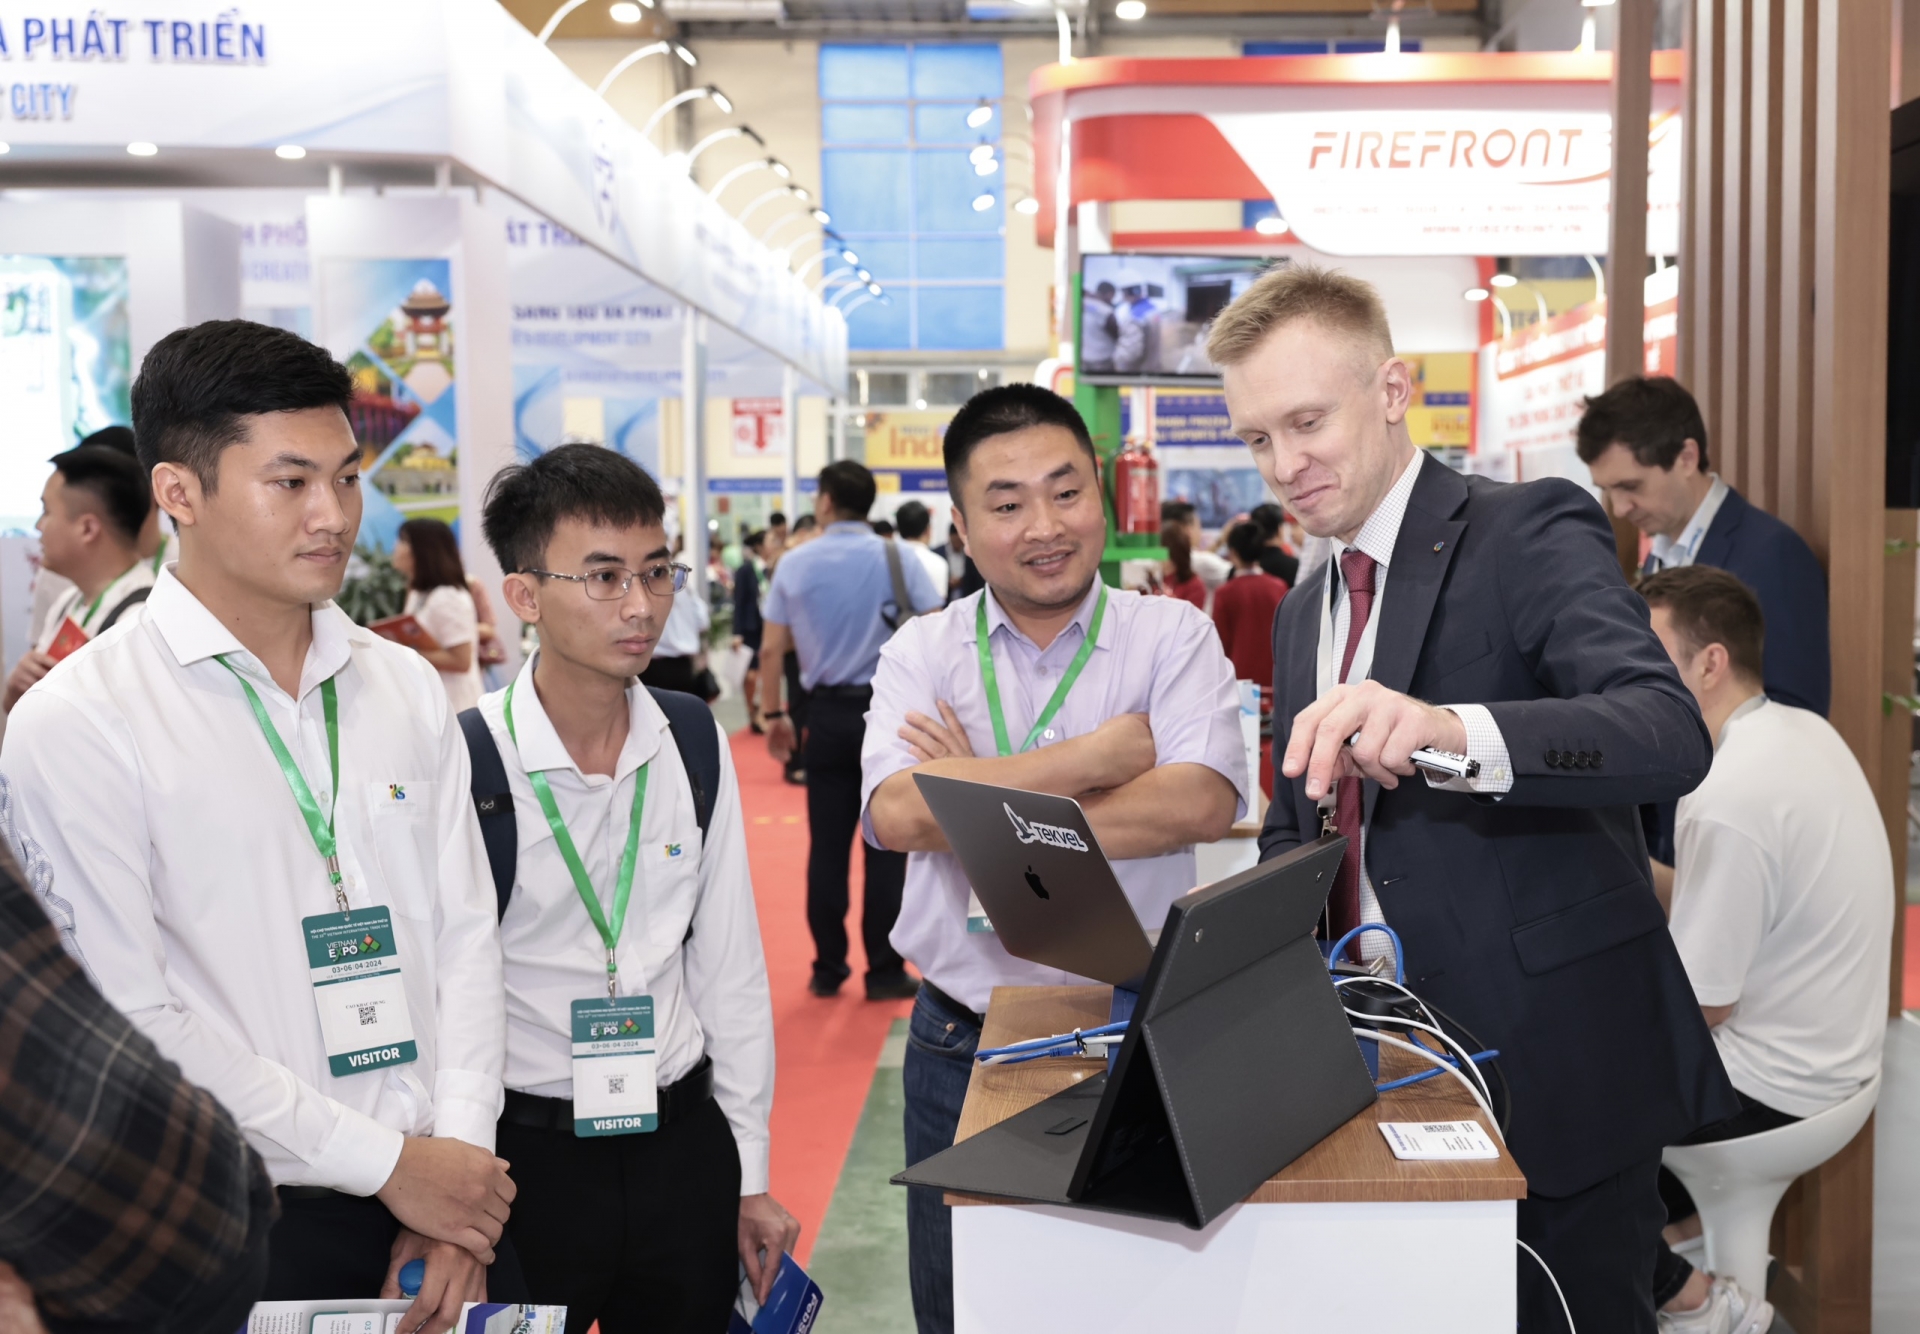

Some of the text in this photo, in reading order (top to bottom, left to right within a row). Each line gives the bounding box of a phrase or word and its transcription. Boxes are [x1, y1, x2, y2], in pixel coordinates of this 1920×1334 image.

[23, 9, 128, 55] PHÁT
[143, 8, 265, 59] TRIỂN
[11, 83, 73, 117] CITY
[1308, 128, 1583, 169] FIREFRONT
[890, 425, 941, 458] Ind
[326, 939, 357, 949] VIETNAM
[329, 945, 358, 962] EXPO
[348, 1047, 401, 1067] VISITOR
[593, 1117, 642, 1131] VISITOR
[364, 1320, 372, 1330] 03
